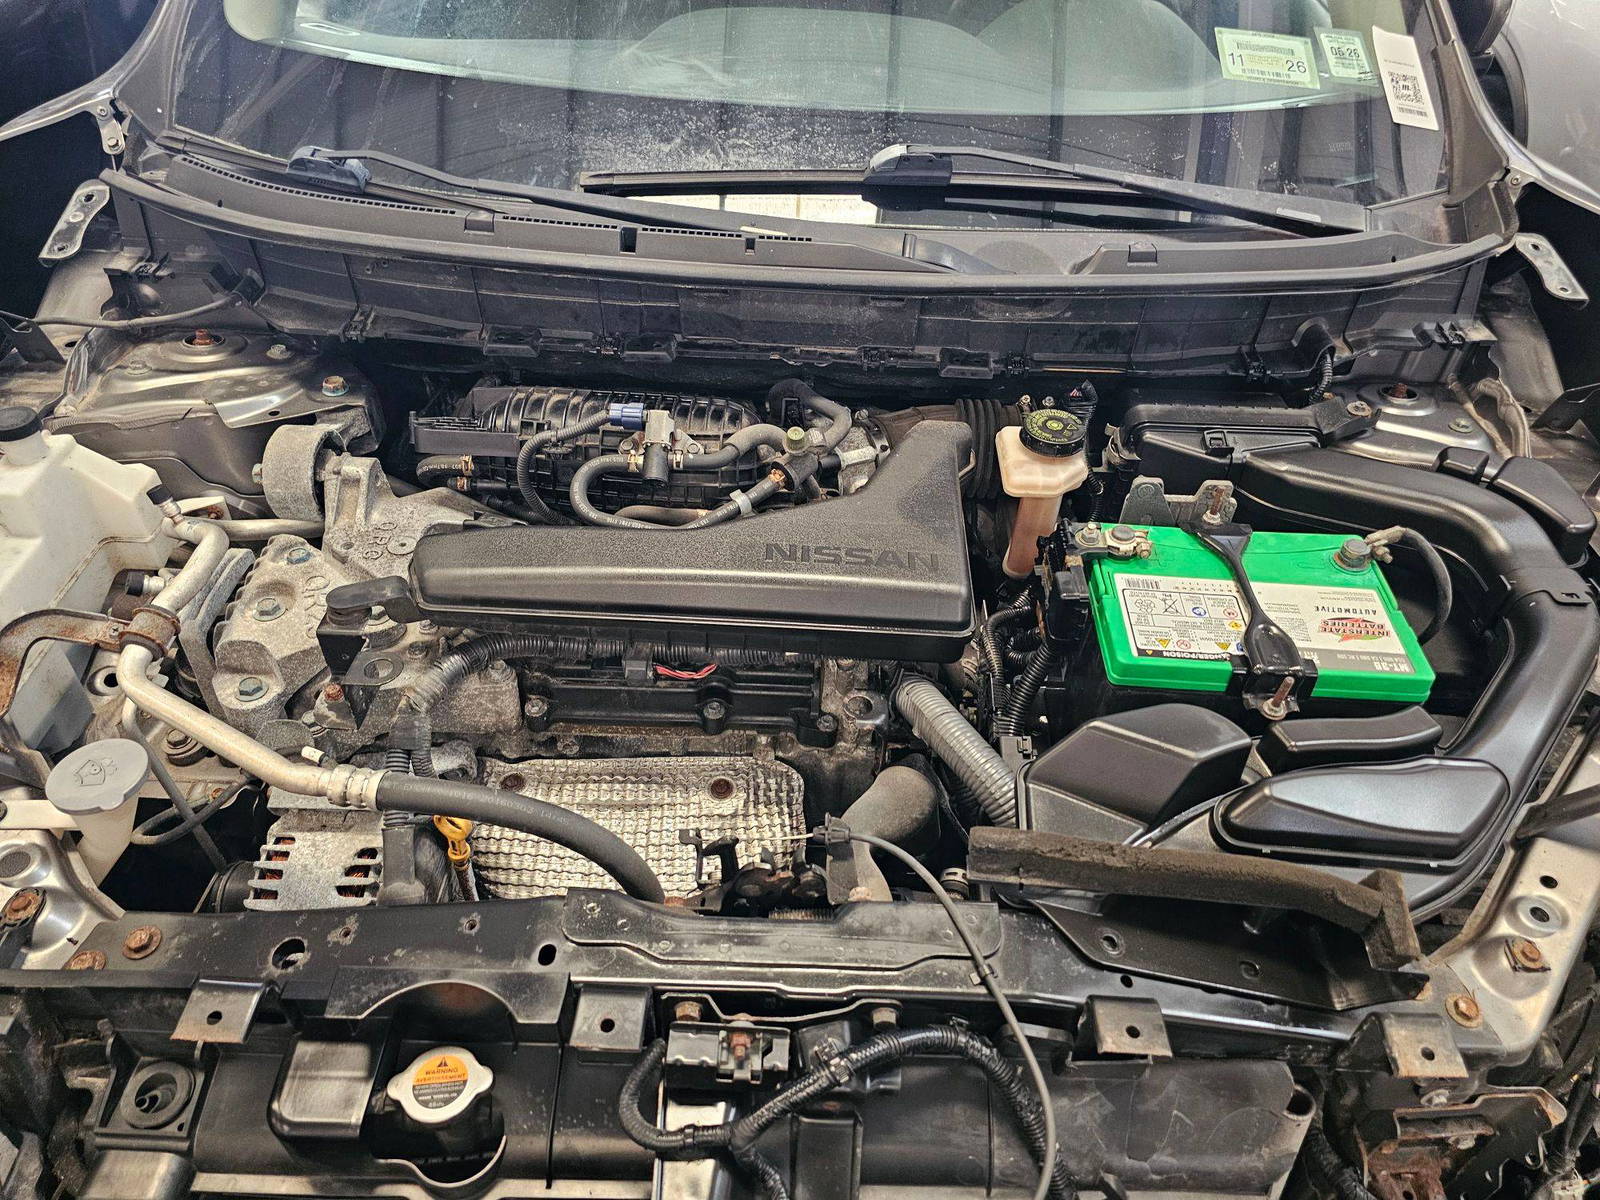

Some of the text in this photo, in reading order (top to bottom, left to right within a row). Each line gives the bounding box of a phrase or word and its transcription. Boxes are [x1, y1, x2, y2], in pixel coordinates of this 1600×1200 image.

[1228, 52, 1244, 66] 11
[1285, 59, 1307, 74] 26
[764, 543, 940, 571] NISSAN
[1314, 605, 1377, 615] AUTOMOTIVE
[1321, 620, 1385, 629] BATTERIES
[1320, 626, 1390, 637] INTERSTATE
[425, 1067, 459, 1075] WARNING
